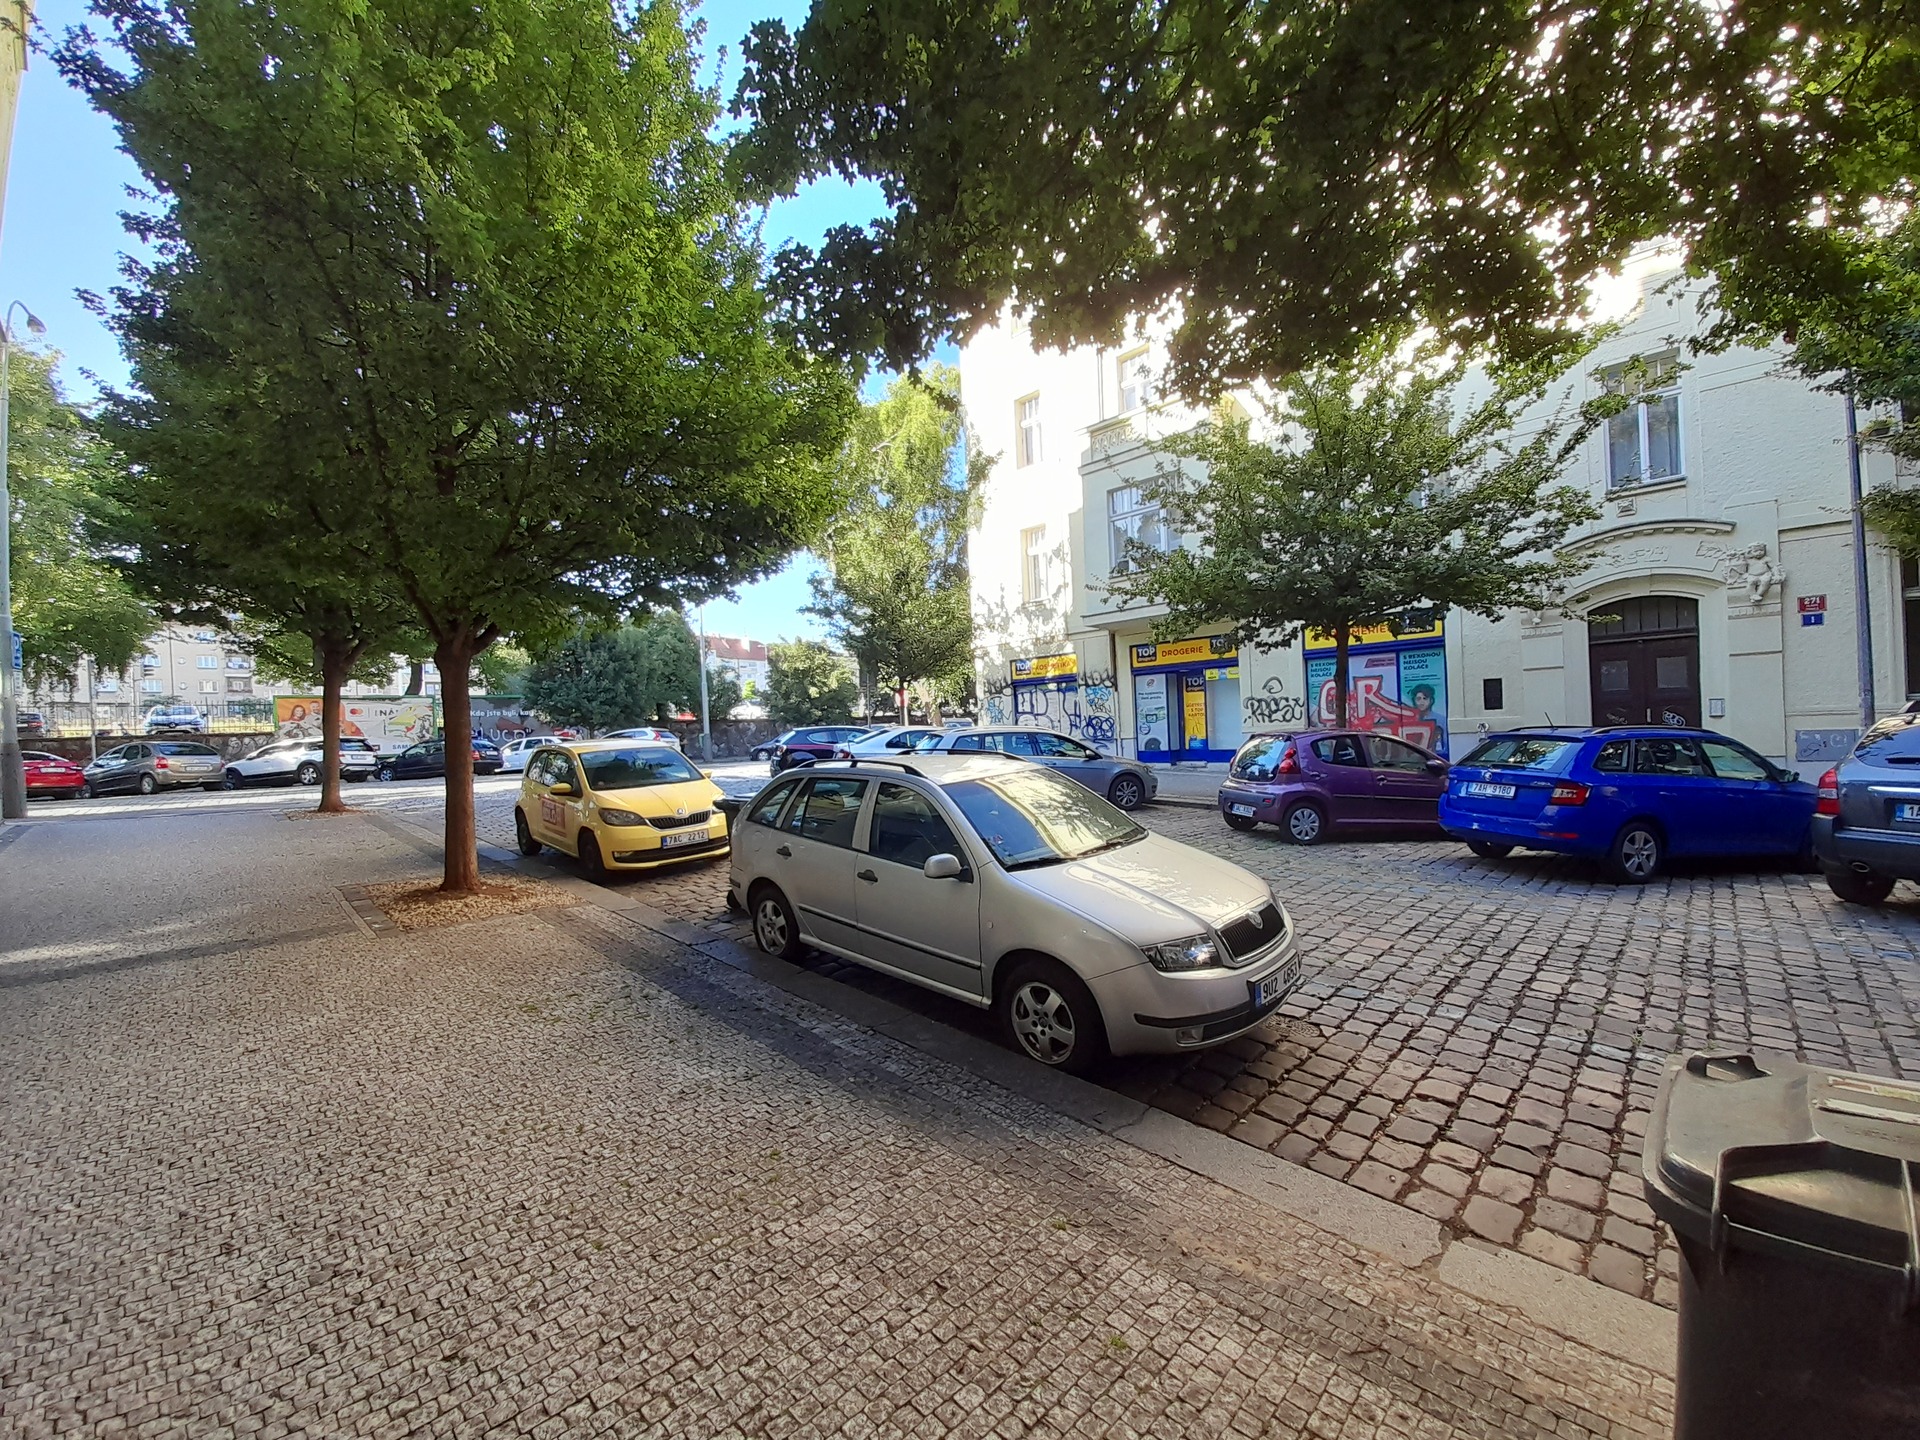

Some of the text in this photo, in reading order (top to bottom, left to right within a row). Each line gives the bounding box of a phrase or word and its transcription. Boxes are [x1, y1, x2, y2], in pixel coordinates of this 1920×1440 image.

[1137, 645, 1204, 658] TOP DROGERIE
[1016, 662, 1030, 671] TOP
[1473, 783, 1512, 795] 7AH 9180
[669, 831, 705, 844] 7AC 2212
[1263, 977, 1278, 1000] 9U2
